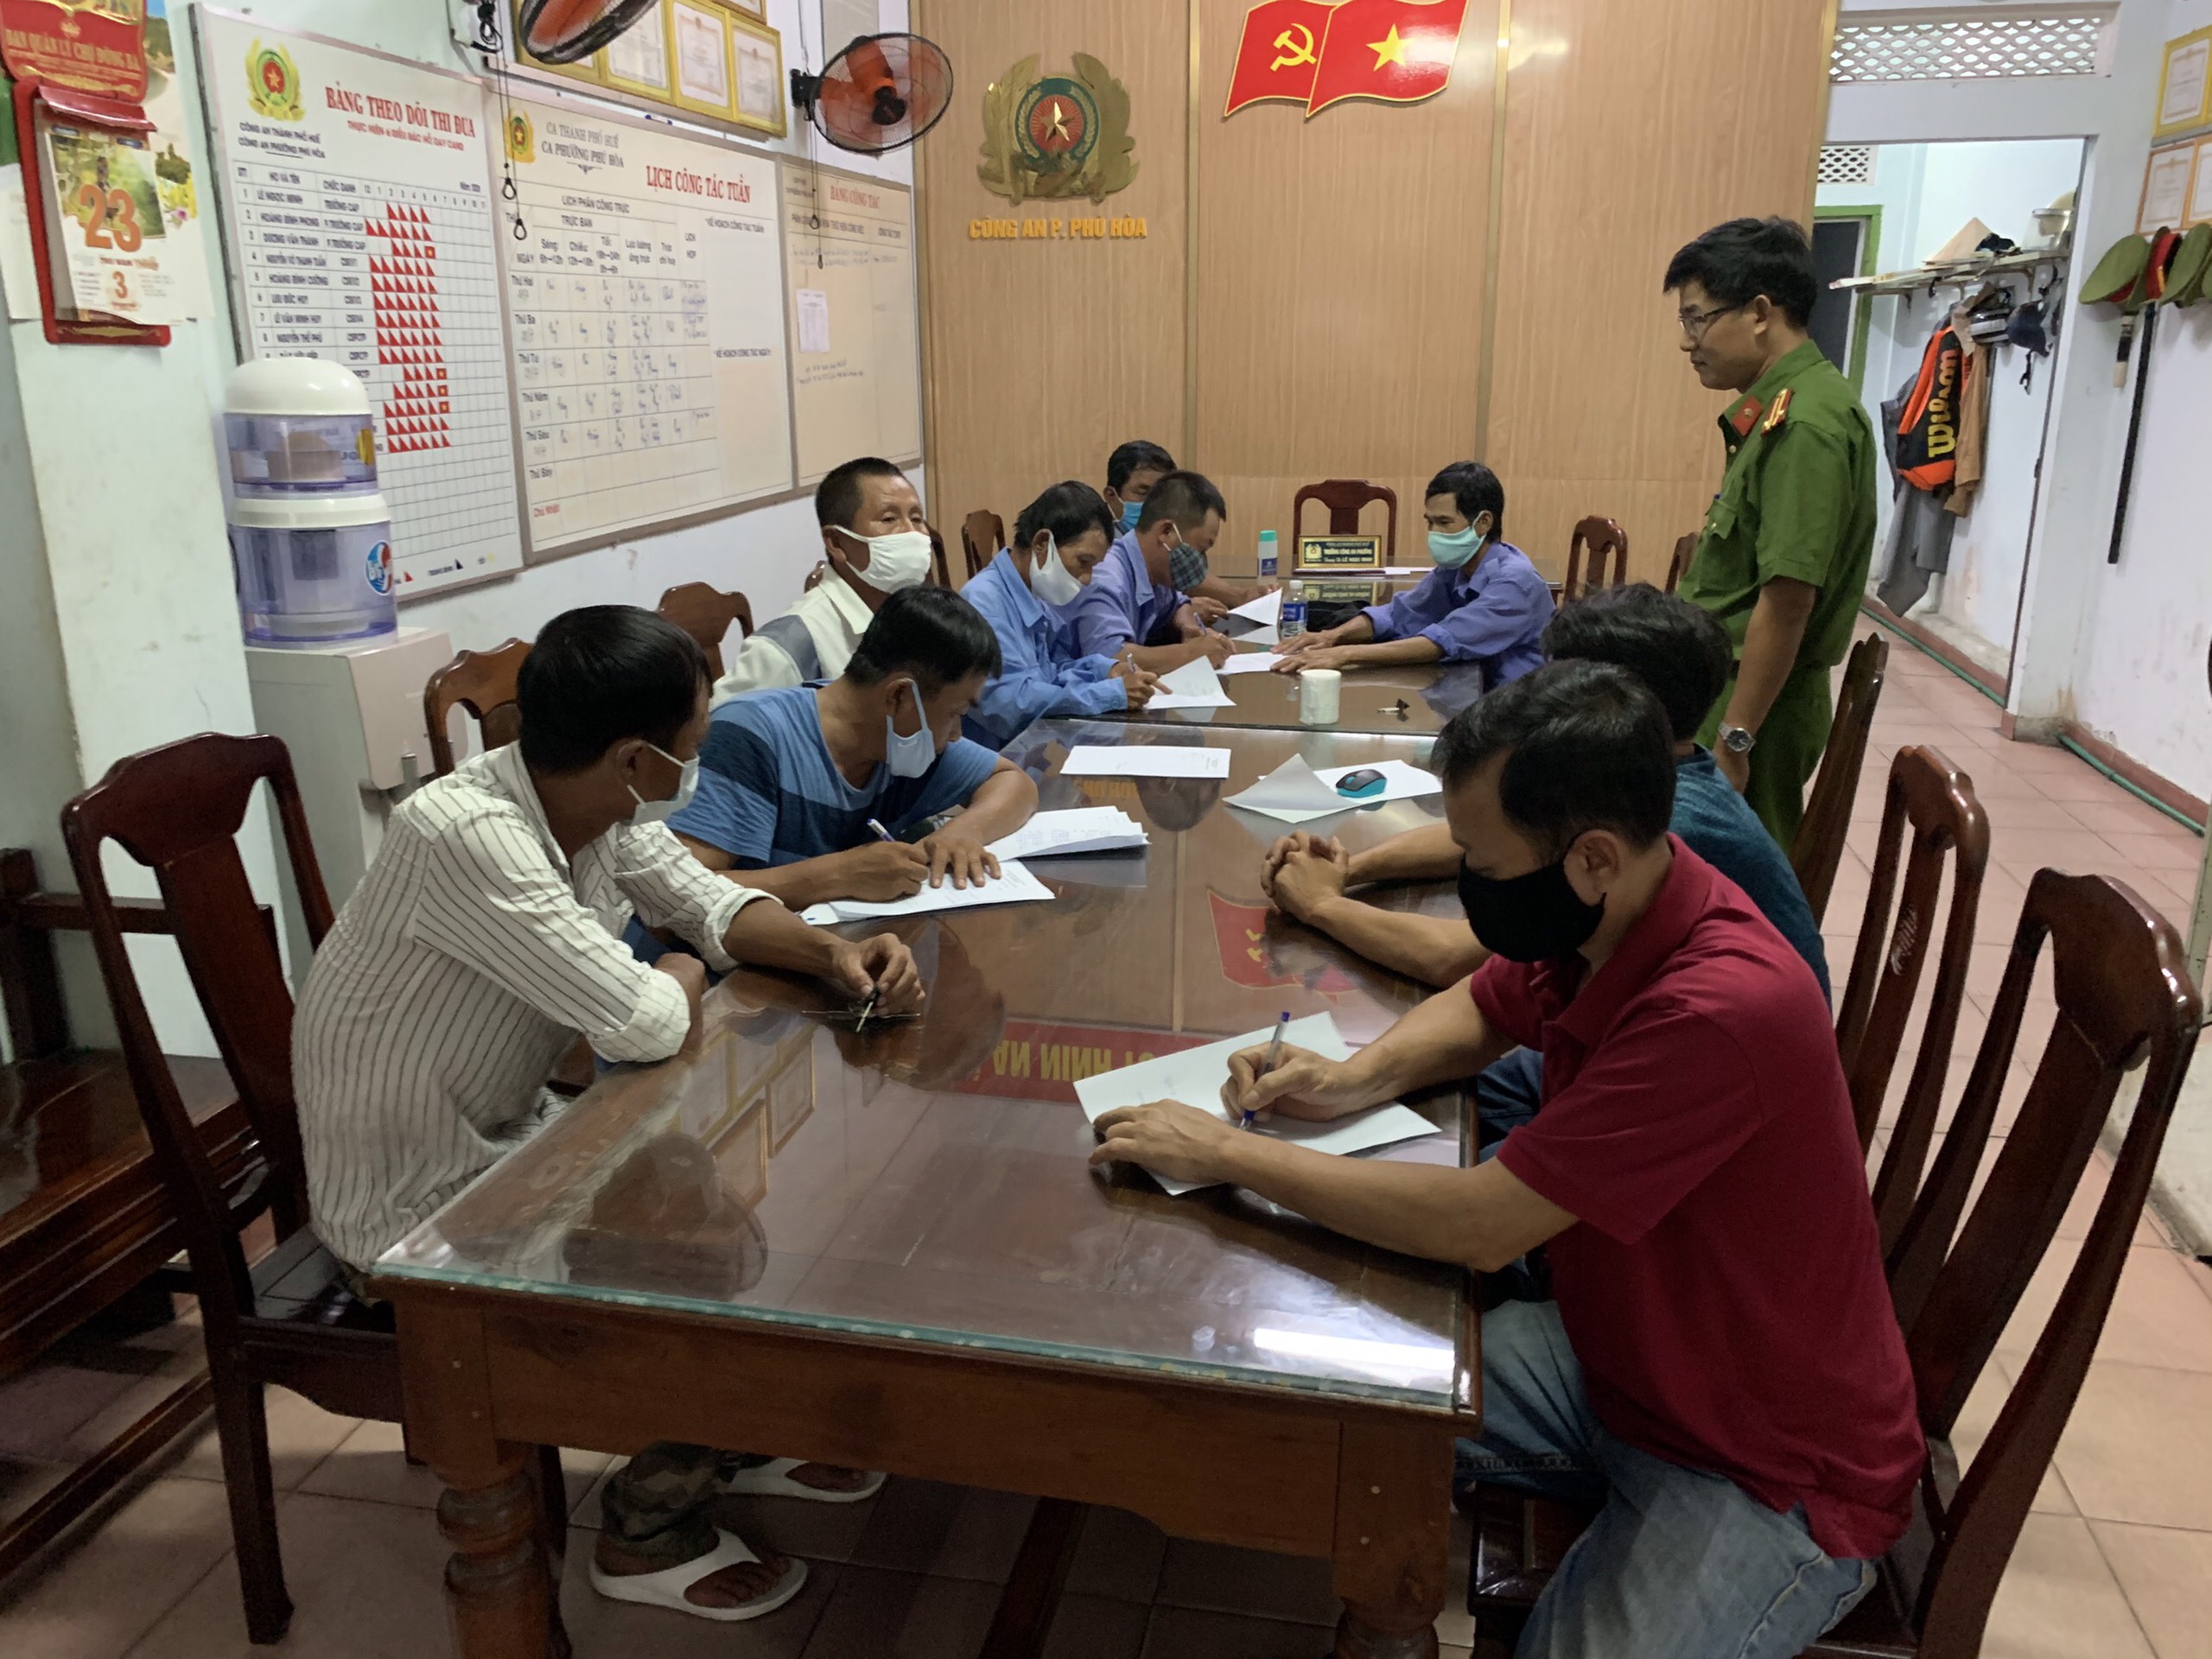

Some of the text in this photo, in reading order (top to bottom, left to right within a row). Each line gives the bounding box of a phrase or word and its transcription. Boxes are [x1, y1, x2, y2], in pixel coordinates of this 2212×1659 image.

[325, 80, 363, 114] BẢNG
[366, 95, 403, 122] THEO
[430, 110, 451, 133] THI
[454, 115, 475, 137] ĐUA
[546, 122, 557, 134] CA
[542, 140, 552, 154] CA
[646, 166, 750, 203] LỊCH CÔNG TÁC TUẦN
[79, 184, 142, 252] 23
[969, 214, 1147, 239] CÔNG AN P. PHÚ HÒA
[112, 271, 127, 298] 3
[1928, 349, 1959, 458] Wilson
